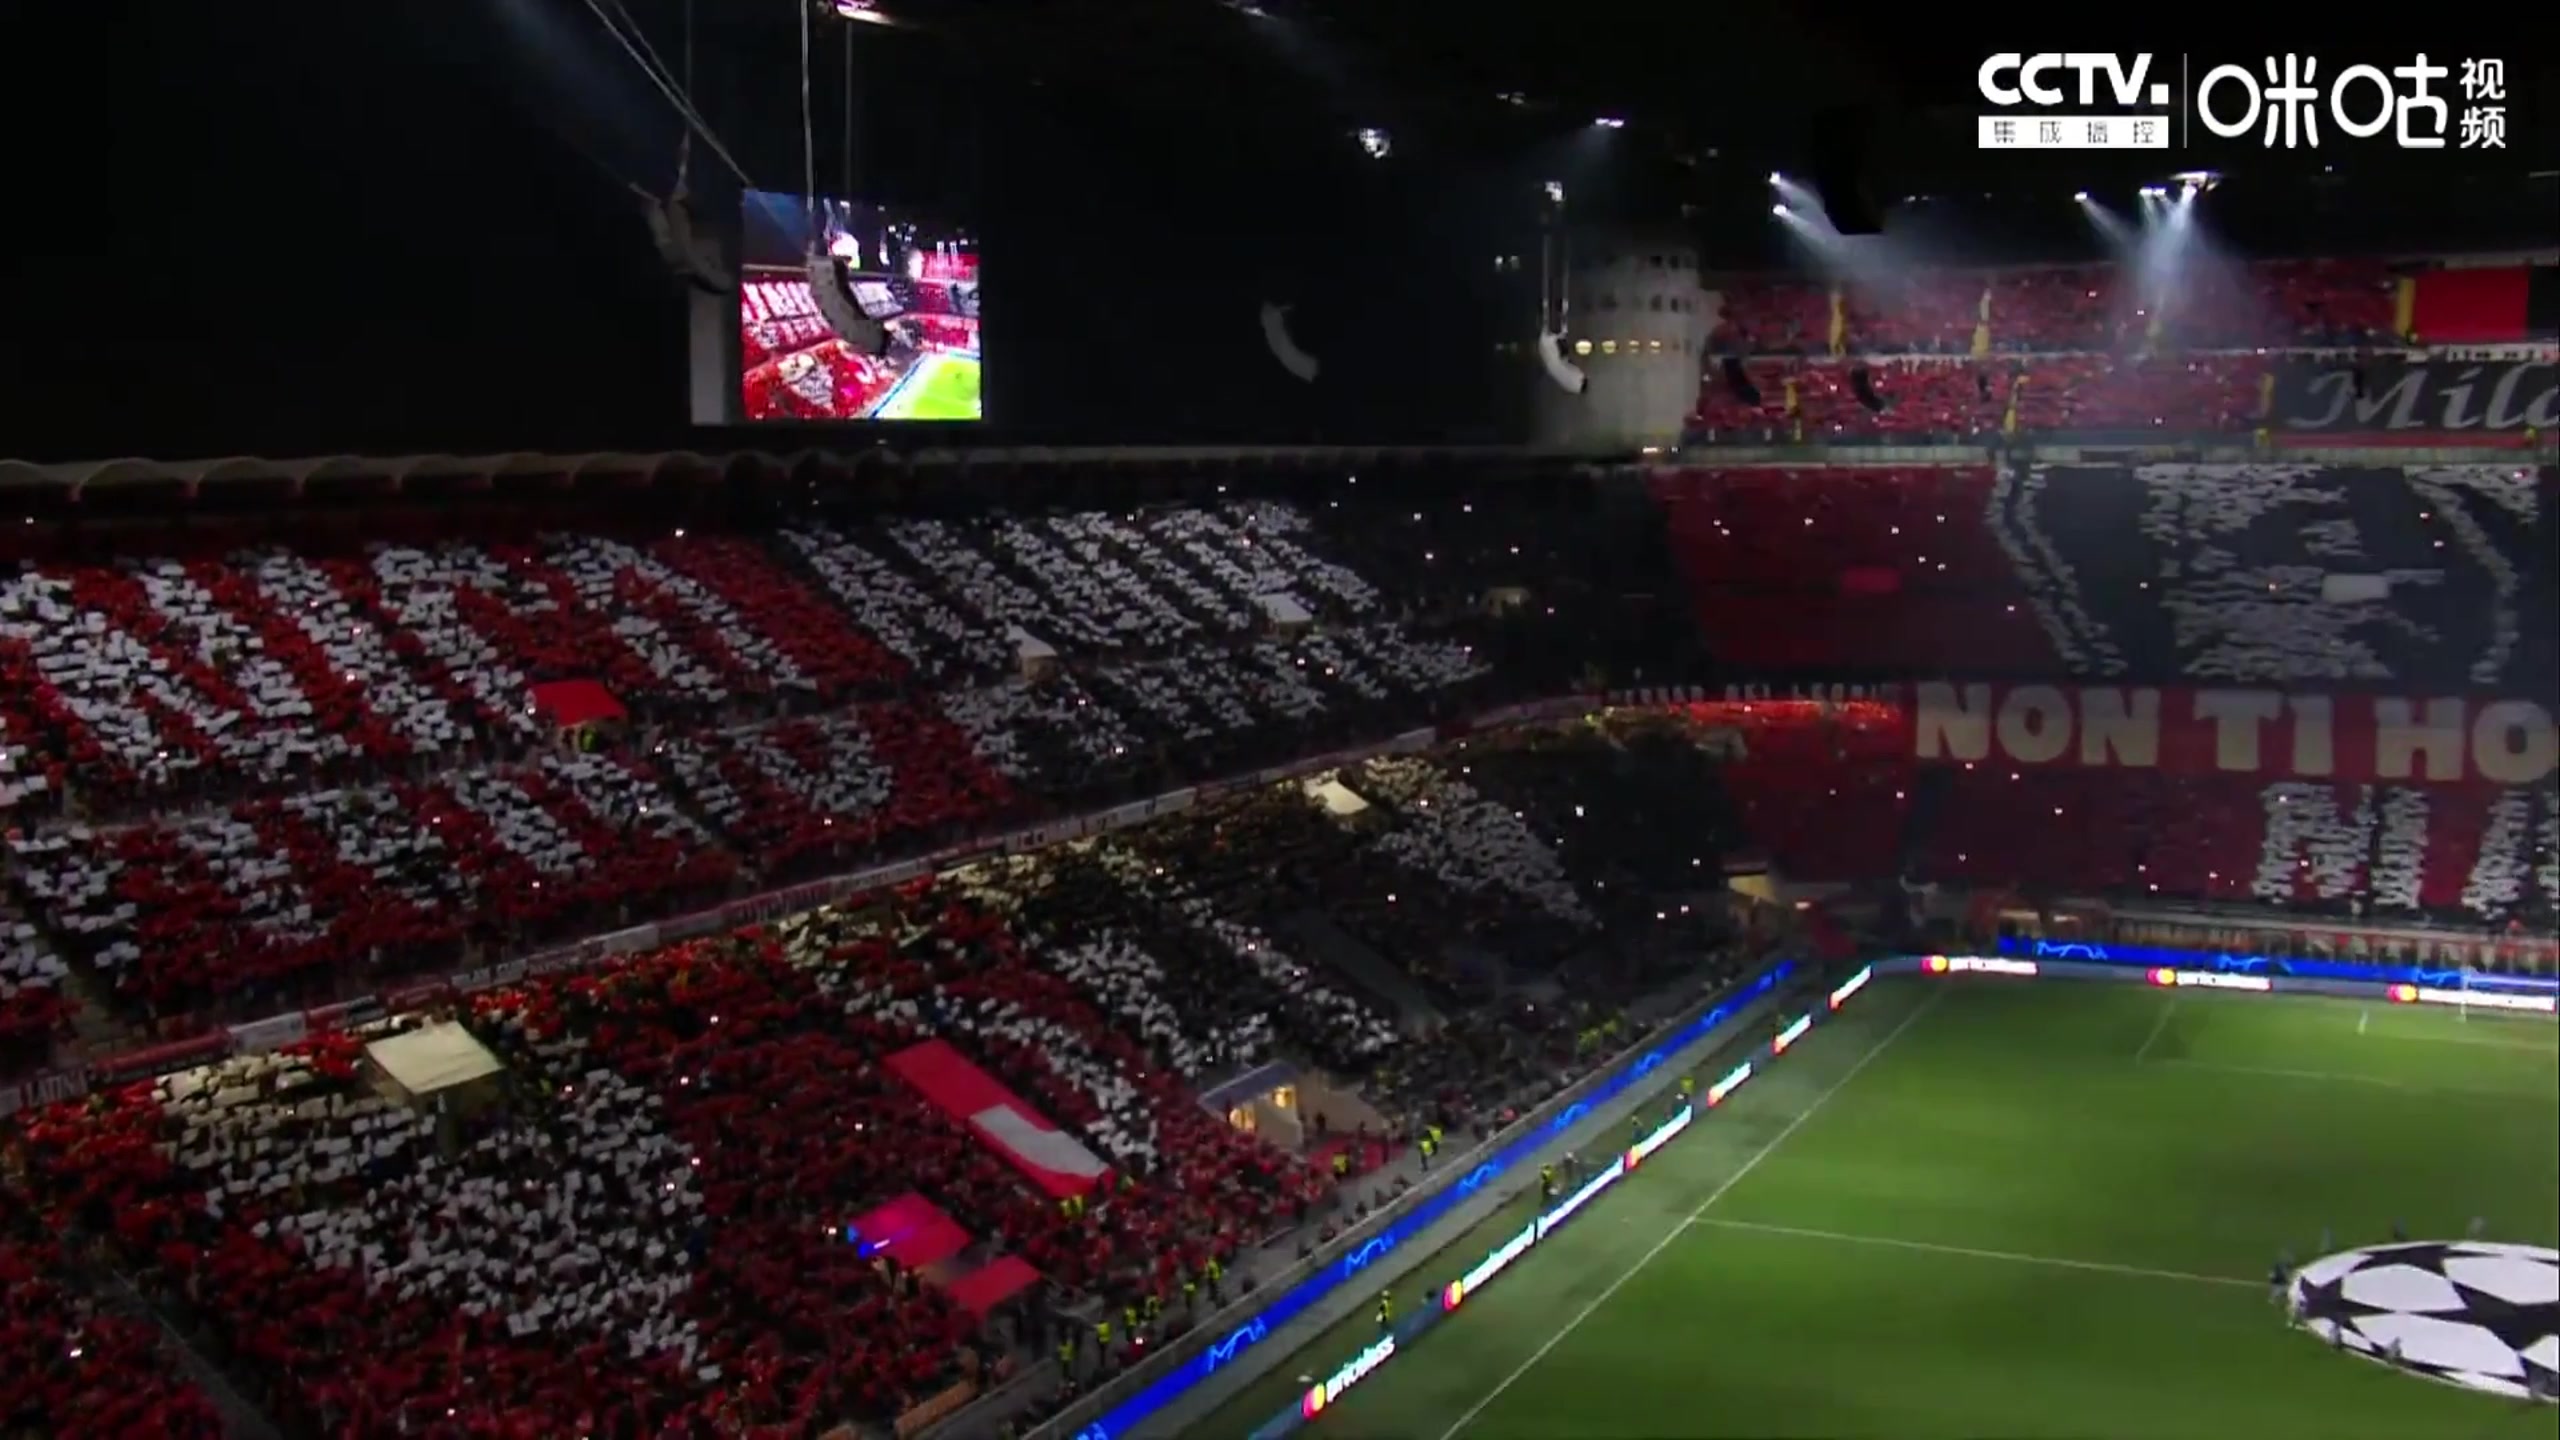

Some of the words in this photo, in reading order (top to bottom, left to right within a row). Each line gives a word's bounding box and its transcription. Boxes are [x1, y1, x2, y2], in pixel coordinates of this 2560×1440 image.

[1915, 681, 2161, 767] NON
[2192, 690, 2335, 777] TI
[2374, 697, 2558, 783] HO
